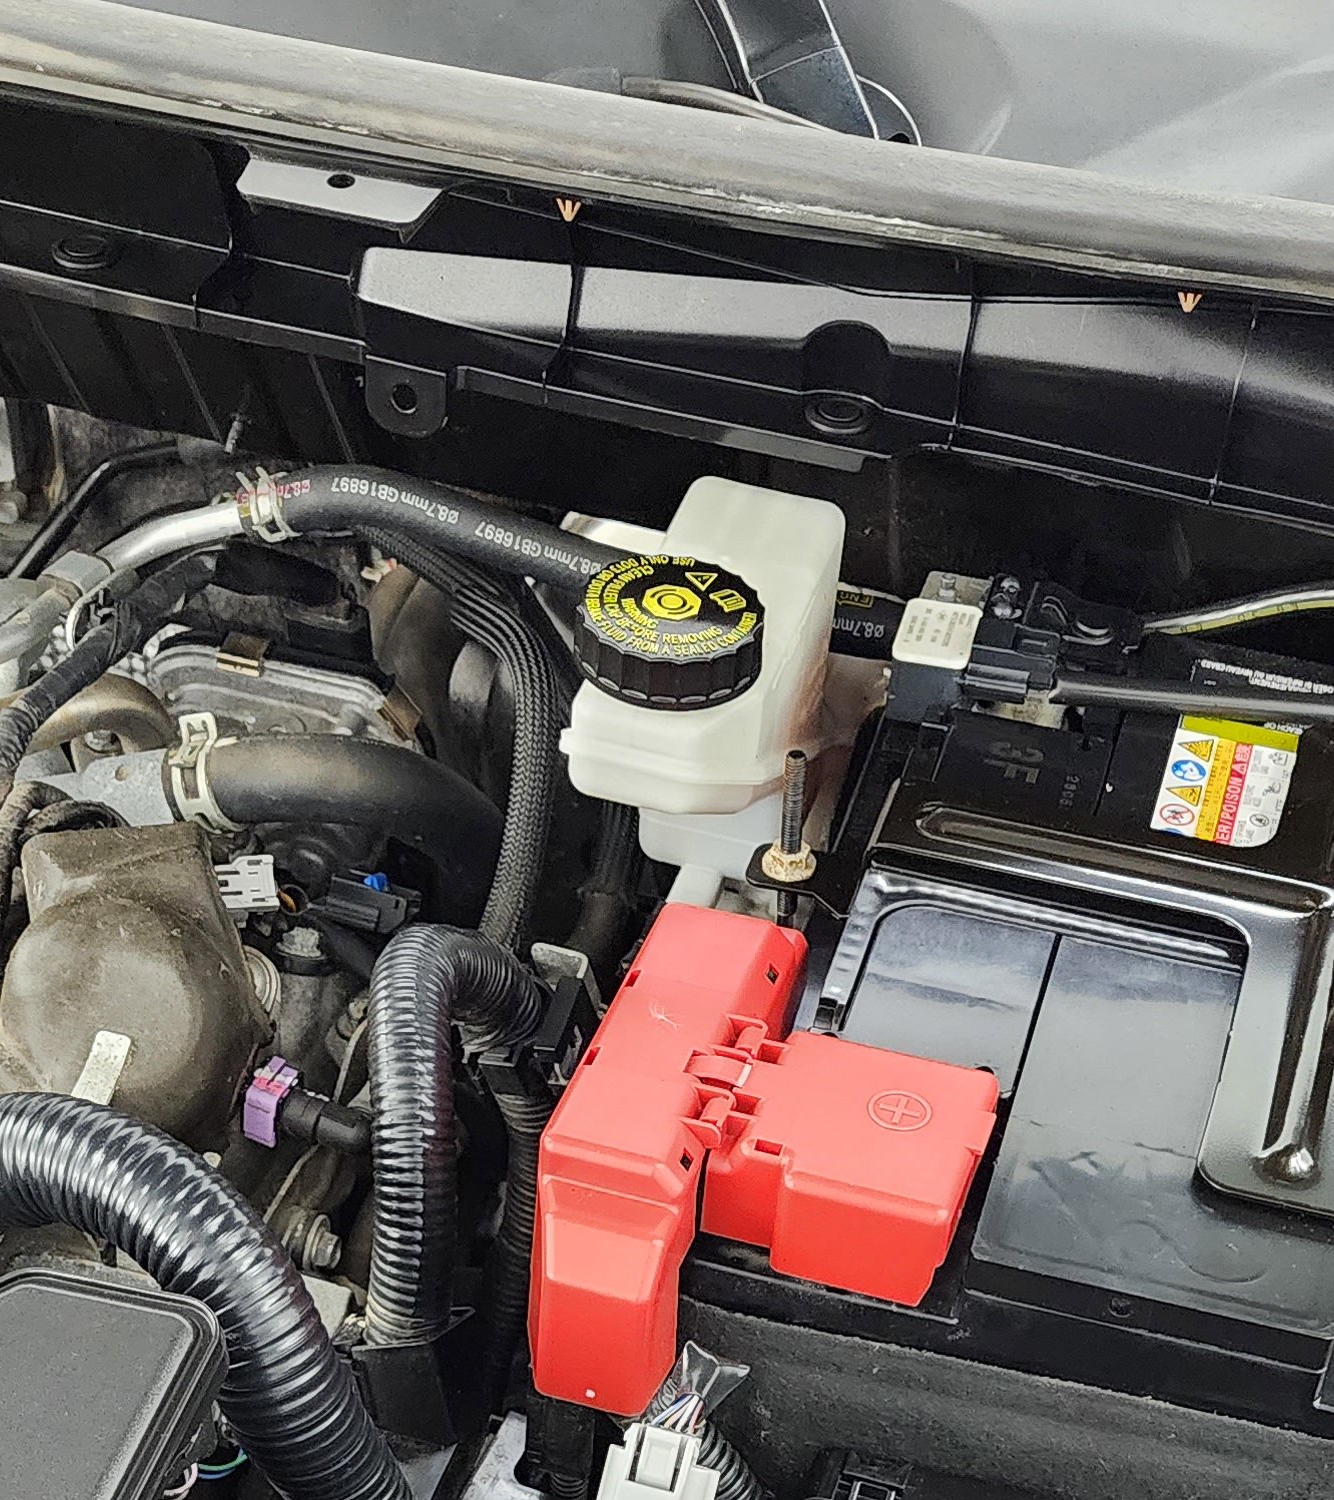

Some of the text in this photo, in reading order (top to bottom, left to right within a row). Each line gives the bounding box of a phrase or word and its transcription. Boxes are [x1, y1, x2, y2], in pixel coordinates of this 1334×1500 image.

[330, 476, 399, 503] GB16897
[474, 520, 542, 557] GB16897
[609, 557, 640, 575] DOT3
[639, 555, 670, 567] ONLY
[671, 556, 696, 567] USE
[617, 565, 655, 584] CLEAN
[604, 603, 624, 619] CAP
[620, 597, 660, 629] WARNING
[598, 620, 628, 642] FLUID
[615, 616, 661, 642] BEFORE
[662, 625, 724, 646] REMOVING
[717, 612, 758, 648] CONTAINER
[627, 636, 660, 655] FROM
[662, 644, 671, 656] A
[674, 640, 719, 656] SEALED
[1216, 774, 1244, 845] ER/POISON
